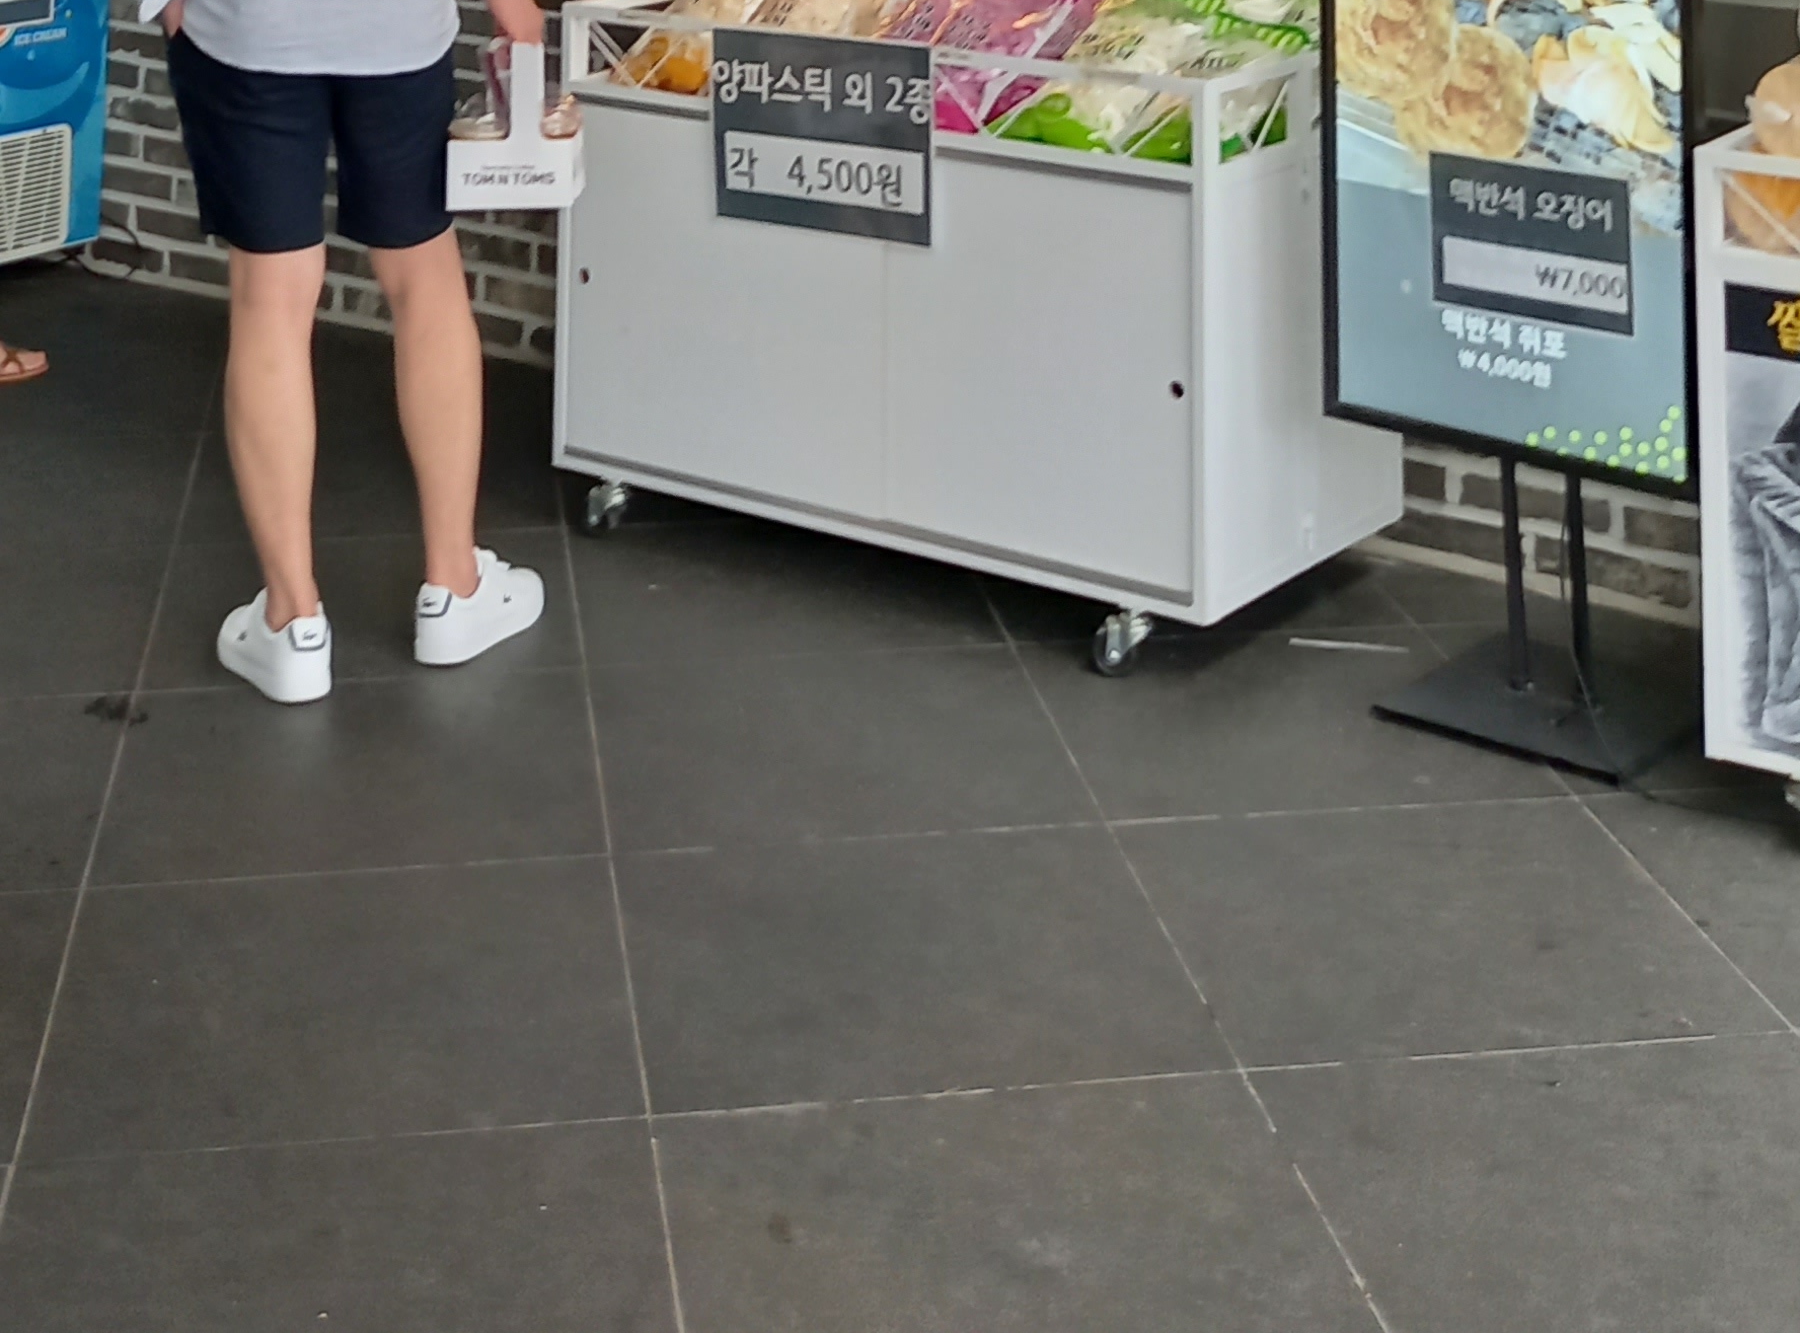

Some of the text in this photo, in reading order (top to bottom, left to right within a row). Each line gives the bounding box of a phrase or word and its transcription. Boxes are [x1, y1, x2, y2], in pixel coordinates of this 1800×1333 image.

[713, 58, 931, 125] 양파스틱 외 2종
[730, 147, 903, 207] 각 4,500원
[1533, 192, 1613, 232] 오징어
